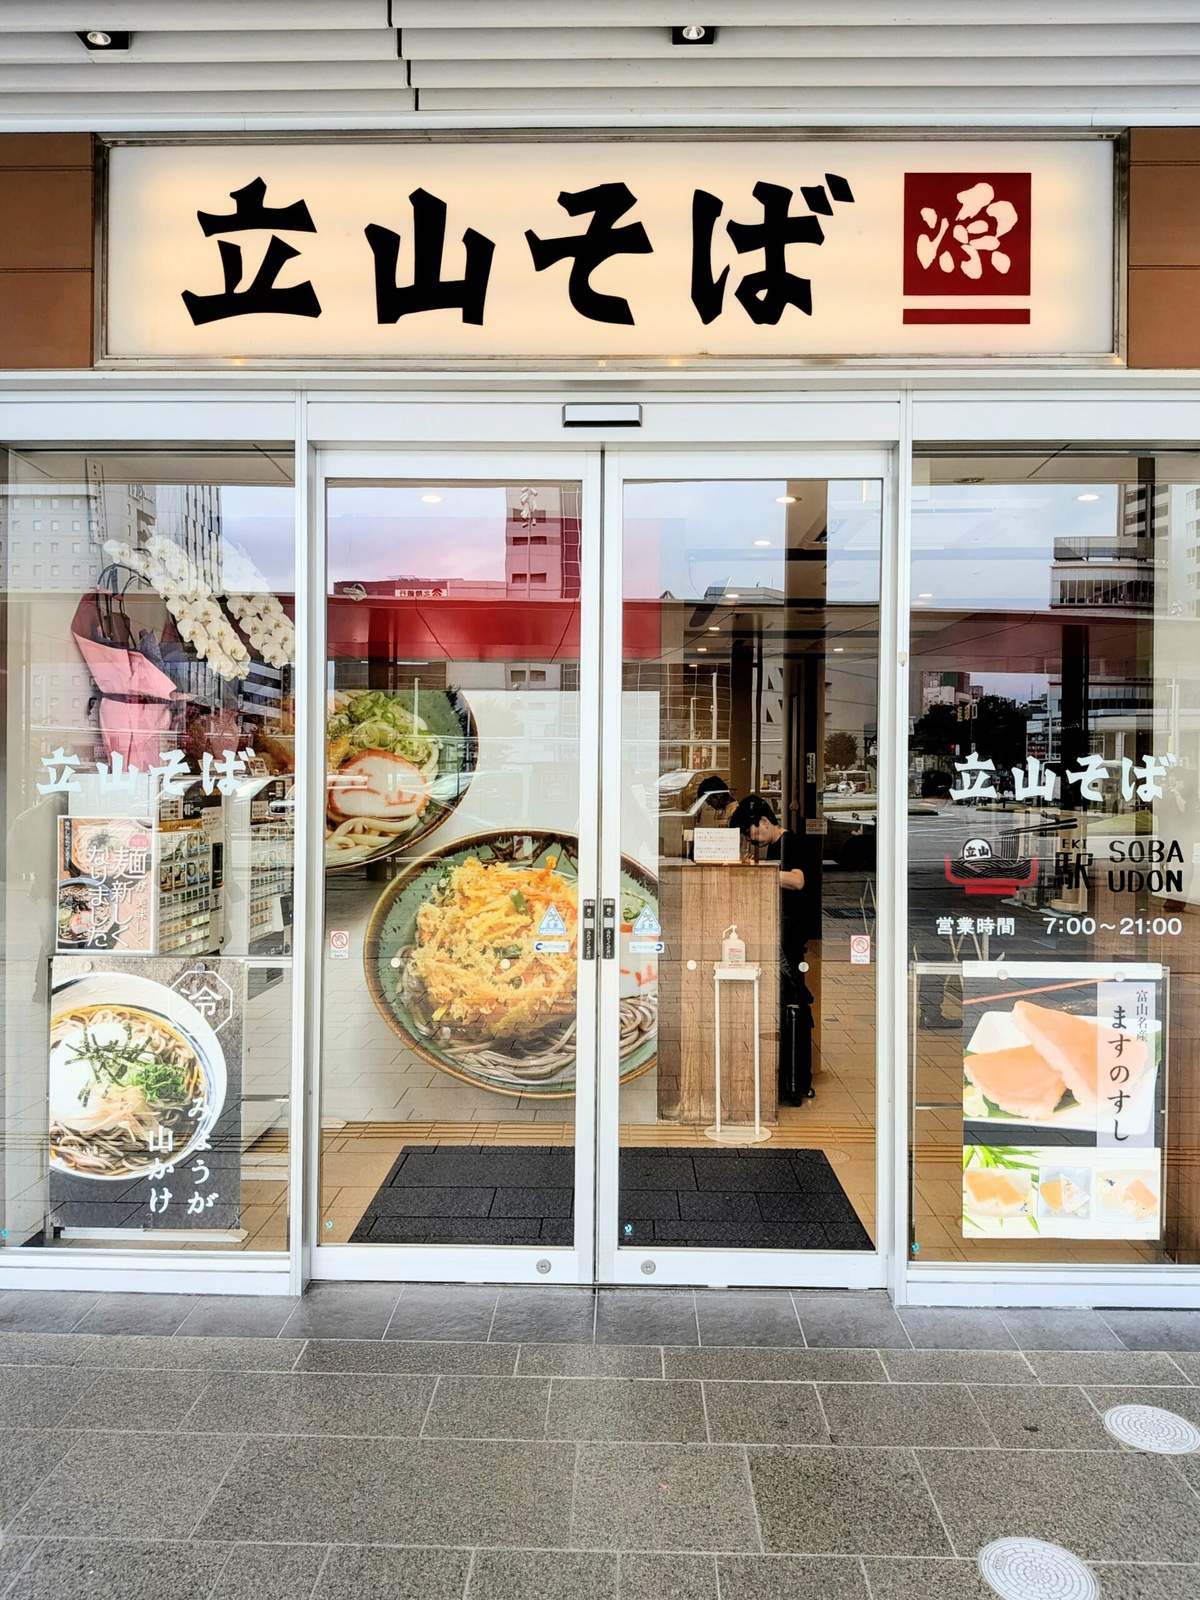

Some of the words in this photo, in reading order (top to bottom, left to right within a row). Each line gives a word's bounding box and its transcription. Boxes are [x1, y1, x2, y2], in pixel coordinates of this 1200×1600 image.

[181, 174, 854, 328] 立山そば
[916, 182, 1018, 280] 源
[36, 746, 256, 796] 立山そば
[949, 751, 1177, 803] 立山そば
[1062, 838, 1087, 849] EKI
[1108, 839, 1185, 864] SOBA
[87, 845, 111, 947] なりました
[1107, 869, 1184, 893] UDON
[936, 917, 1016, 936] 営業時間
[1107, 1004, 1131, 1142] ますのすし
[148, 1125, 175, 1214] 山かけ
